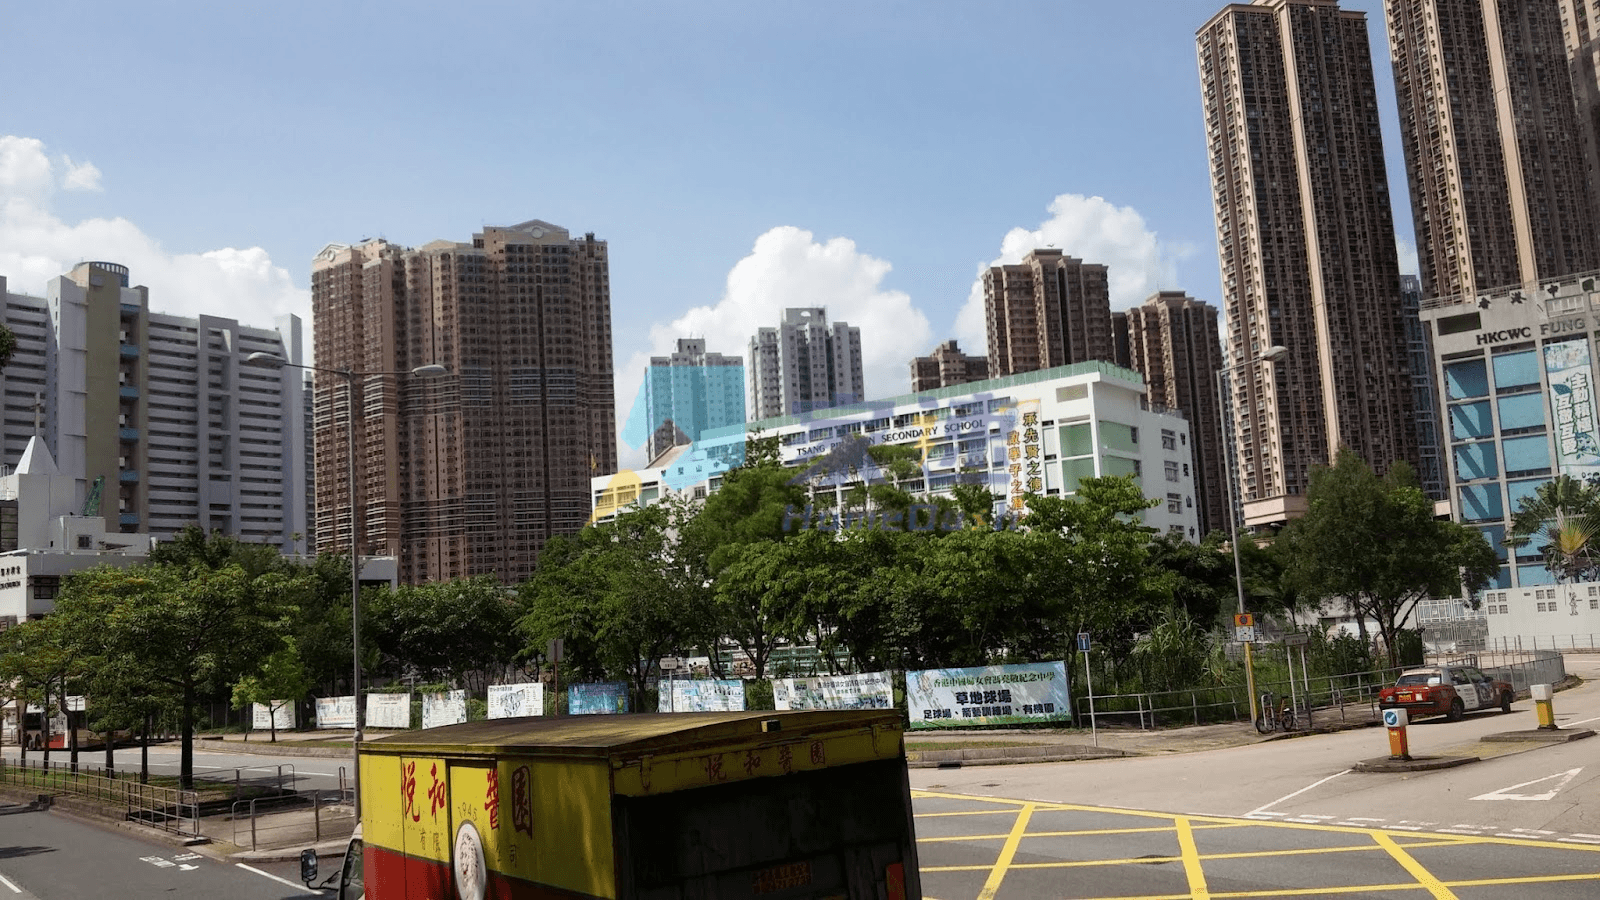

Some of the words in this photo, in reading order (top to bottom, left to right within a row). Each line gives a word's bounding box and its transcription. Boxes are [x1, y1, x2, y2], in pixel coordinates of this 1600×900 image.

[1476, 326, 1532, 345] HKCWC
[1539, 318, 1586, 336] FUNG
[796, 443, 826, 456] TSANG
[881, 426, 938, 443] SECONDARY
[944, 418, 986, 433] SCHOOL
[955, 689, 1012, 706] 草地球場
